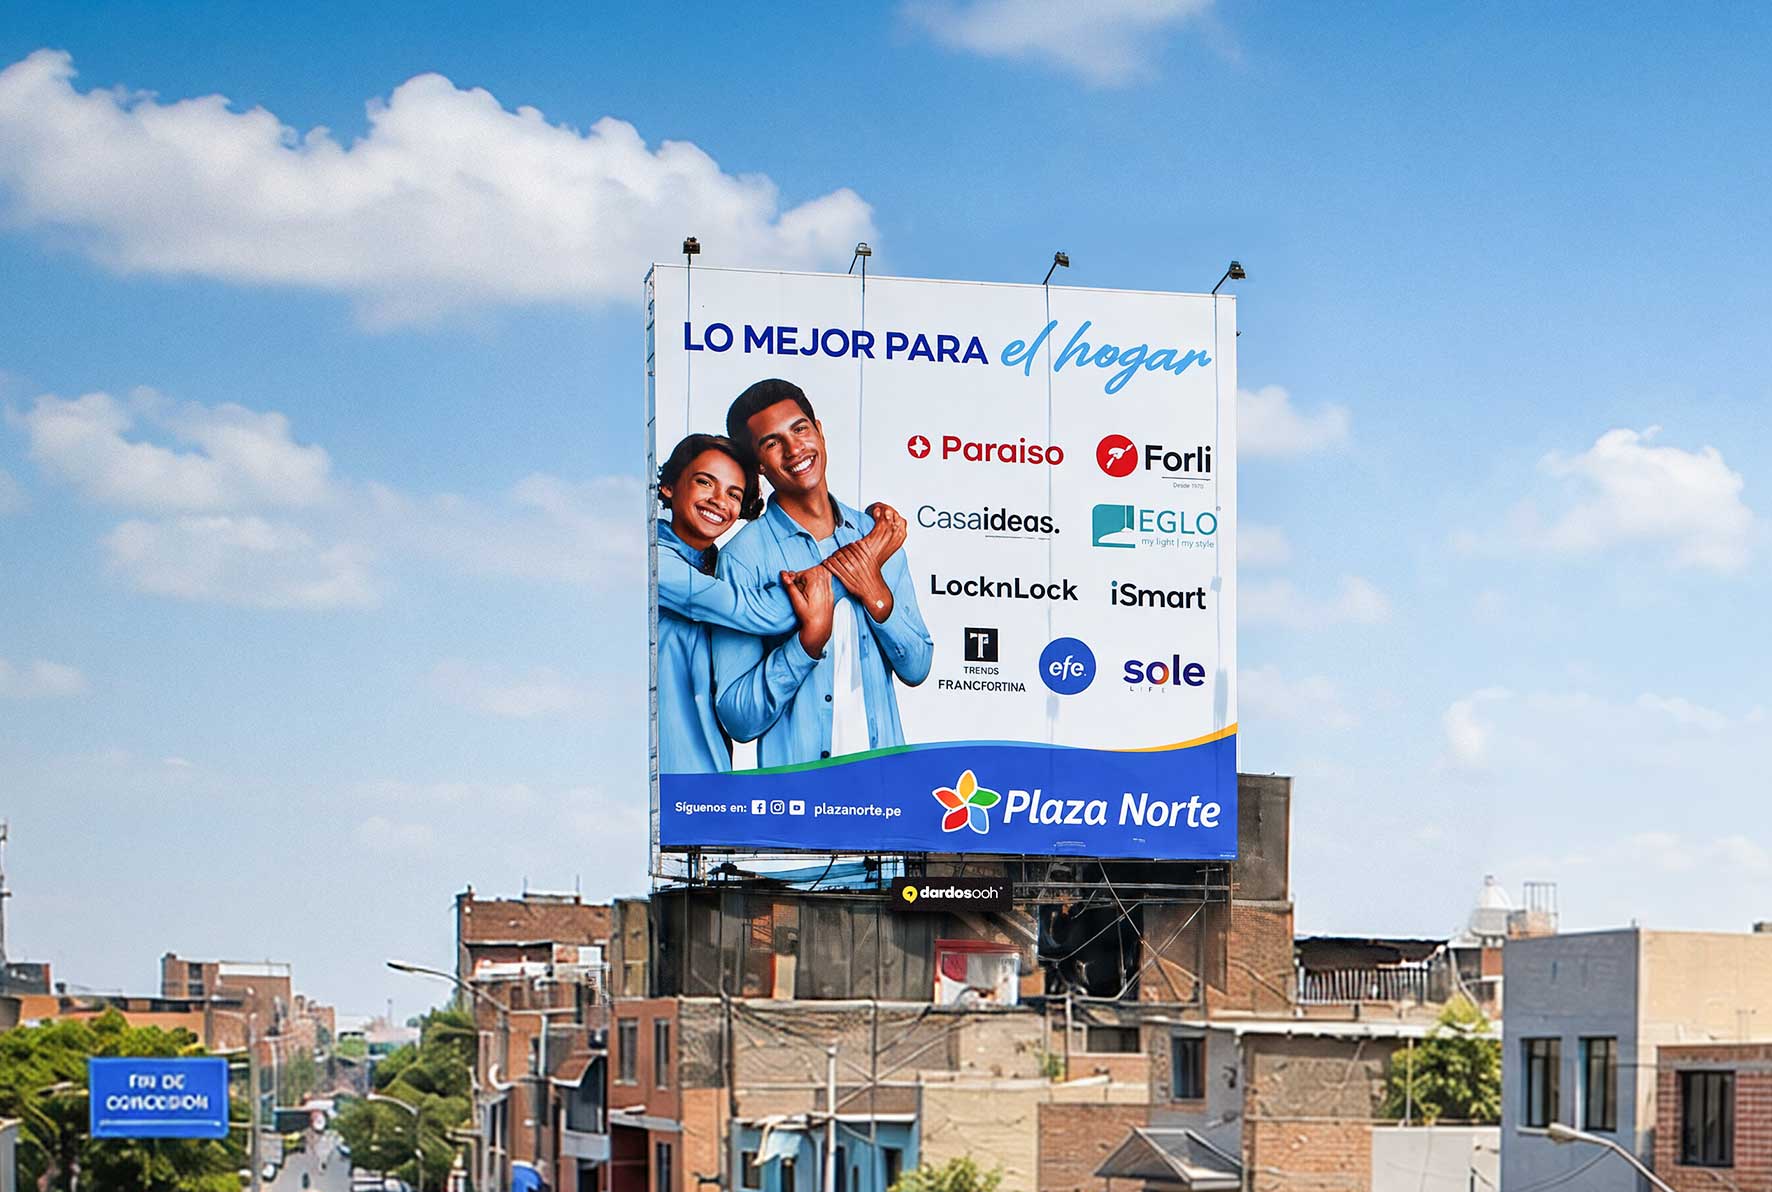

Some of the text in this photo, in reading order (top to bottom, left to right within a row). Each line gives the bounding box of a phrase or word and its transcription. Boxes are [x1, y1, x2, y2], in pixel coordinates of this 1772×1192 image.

[683, 319, 1213, 396] LO MEJOR PARA el hogar
[942, 435, 1065, 466] Paraiso
[1144, 444, 1212, 474] Forli
[1139, 509, 1218, 536] EGLO
[1141, 537, 1215, 549] my light my style
[930, 574, 1079, 602] LocknLock
[1110, 580, 1207, 611] iSmart
[963, 666, 1000, 676] TRENDS
[1123, 654, 1206, 687] sole
[938, 679, 1026, 693] FRANCFORTINA
[675, 801, 747, 815] Síguenos en:
[814, 802, 902, 819] plazanorte.pe
[1003, 789, 1221, 828] Plaza Norte
